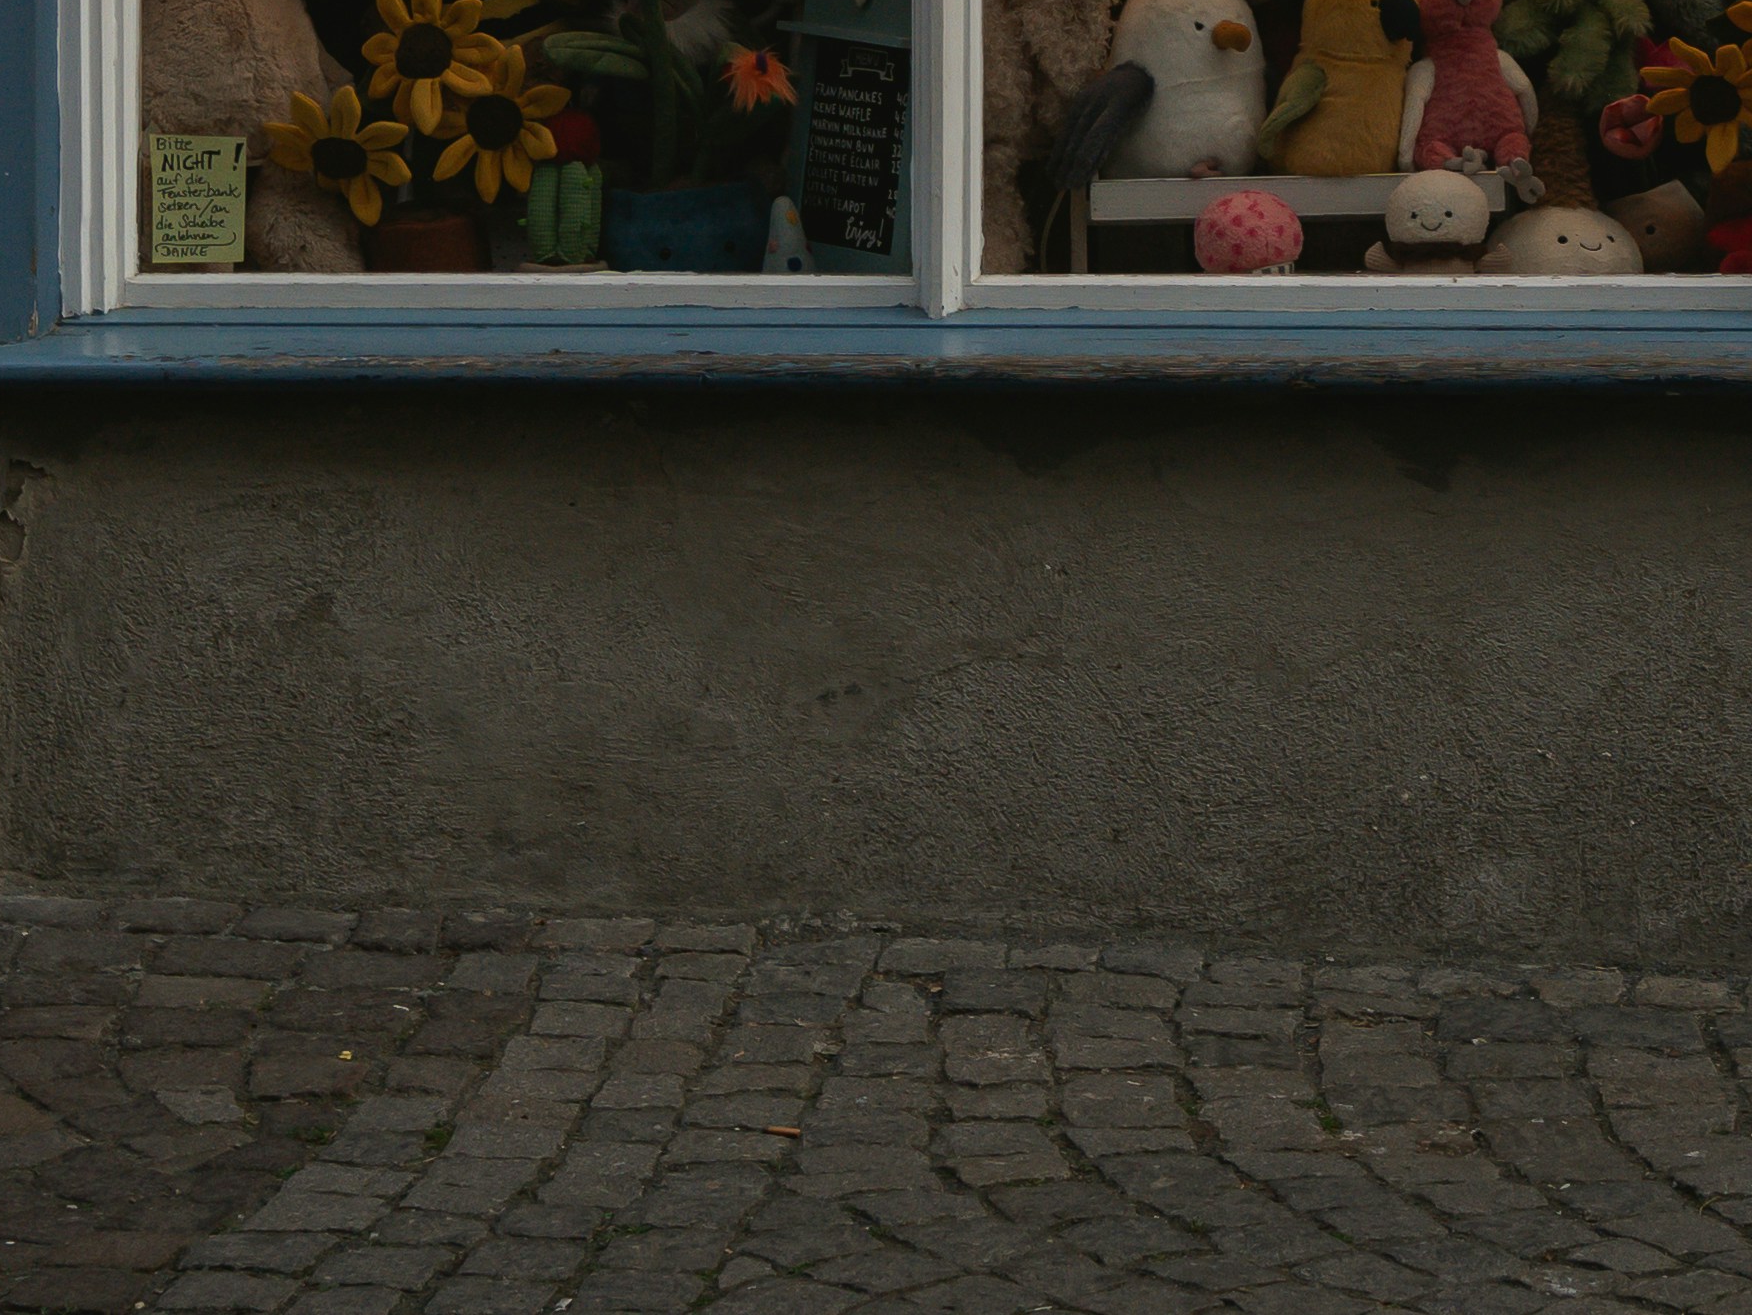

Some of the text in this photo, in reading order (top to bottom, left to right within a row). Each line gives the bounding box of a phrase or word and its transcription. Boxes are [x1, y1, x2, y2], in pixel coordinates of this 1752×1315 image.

[838, 86, 882, 105] PANCAKES
[838, 103, 872, 121] WAFFLE
[156, 137, 194, 151] Bitte
[810, 134, 852, 150] CINNAMON
[855, 139, 875, 154] BUN
[162, 150, 221, 171] NICHT
[157, 173, 205, 186] auf die
[157, 183, 241, 199] Fensterbank
[832, 197, 866, 215] TEAPOT
[156, 214, 226, 230] die Scheibe
[162, 230, 219, 242] anlehnen
[160, 246, 208, 258] DANKE
